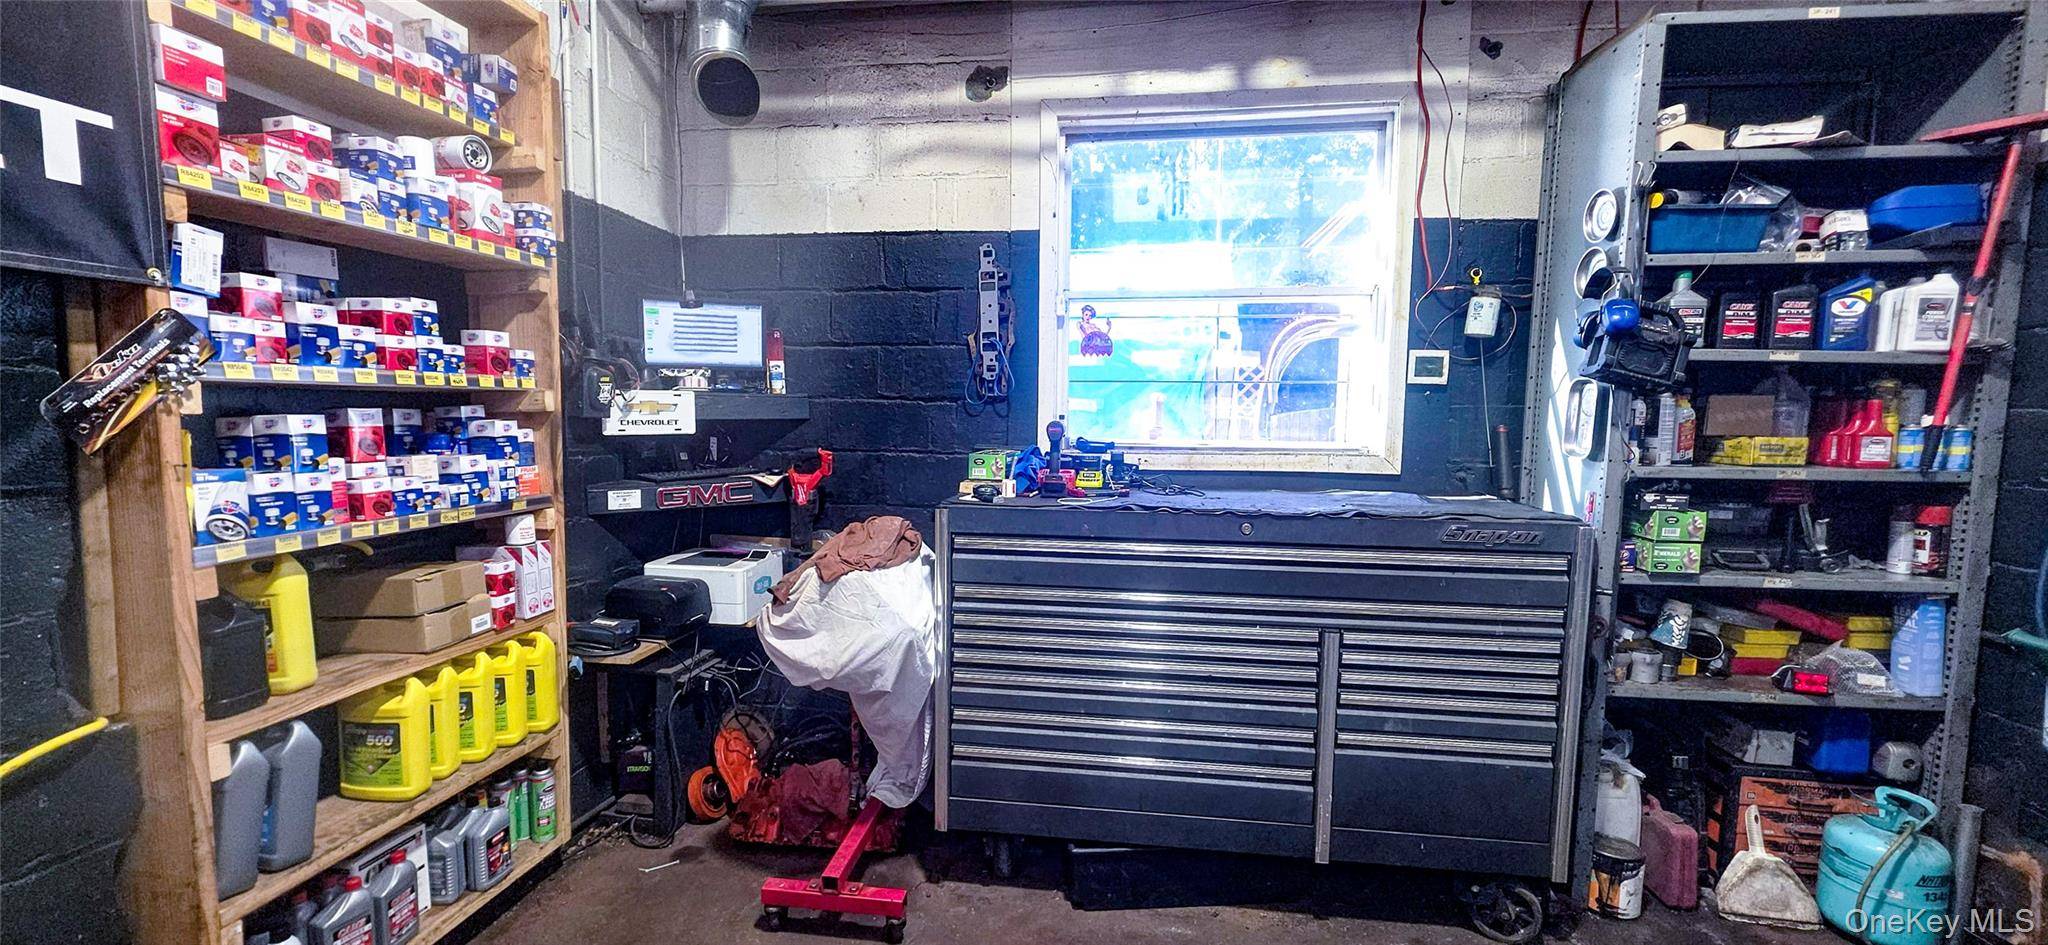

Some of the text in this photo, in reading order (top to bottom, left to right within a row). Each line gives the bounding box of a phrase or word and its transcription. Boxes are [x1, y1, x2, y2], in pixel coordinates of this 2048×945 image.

[0, 85, 113, 185] T
[82, 337, 171, 409] Replacement Terminals
[620, 418, 679, 427] CHEVROLET
[657, 480, 753, 509] GMC
[366, 734, 394, 747] 500
